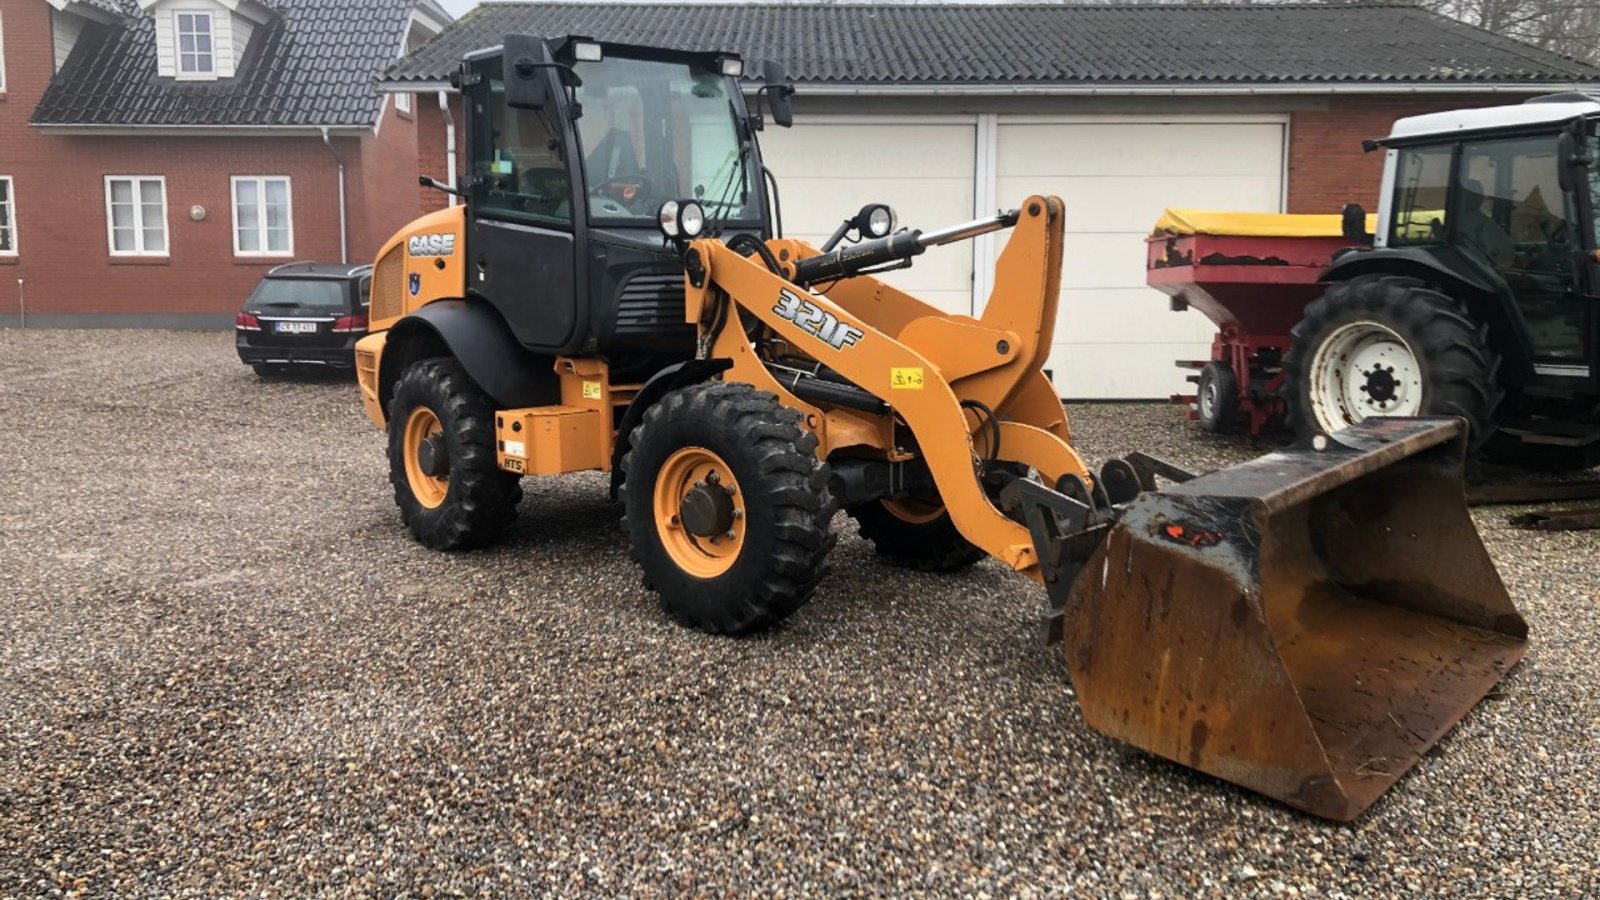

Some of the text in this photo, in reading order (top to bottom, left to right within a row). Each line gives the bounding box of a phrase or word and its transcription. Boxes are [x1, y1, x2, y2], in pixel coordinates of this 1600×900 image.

[408, 233, 456, 256] CASE
[771, 287, 865, 351] 321F
[504, 458, 522, 471] HTS
